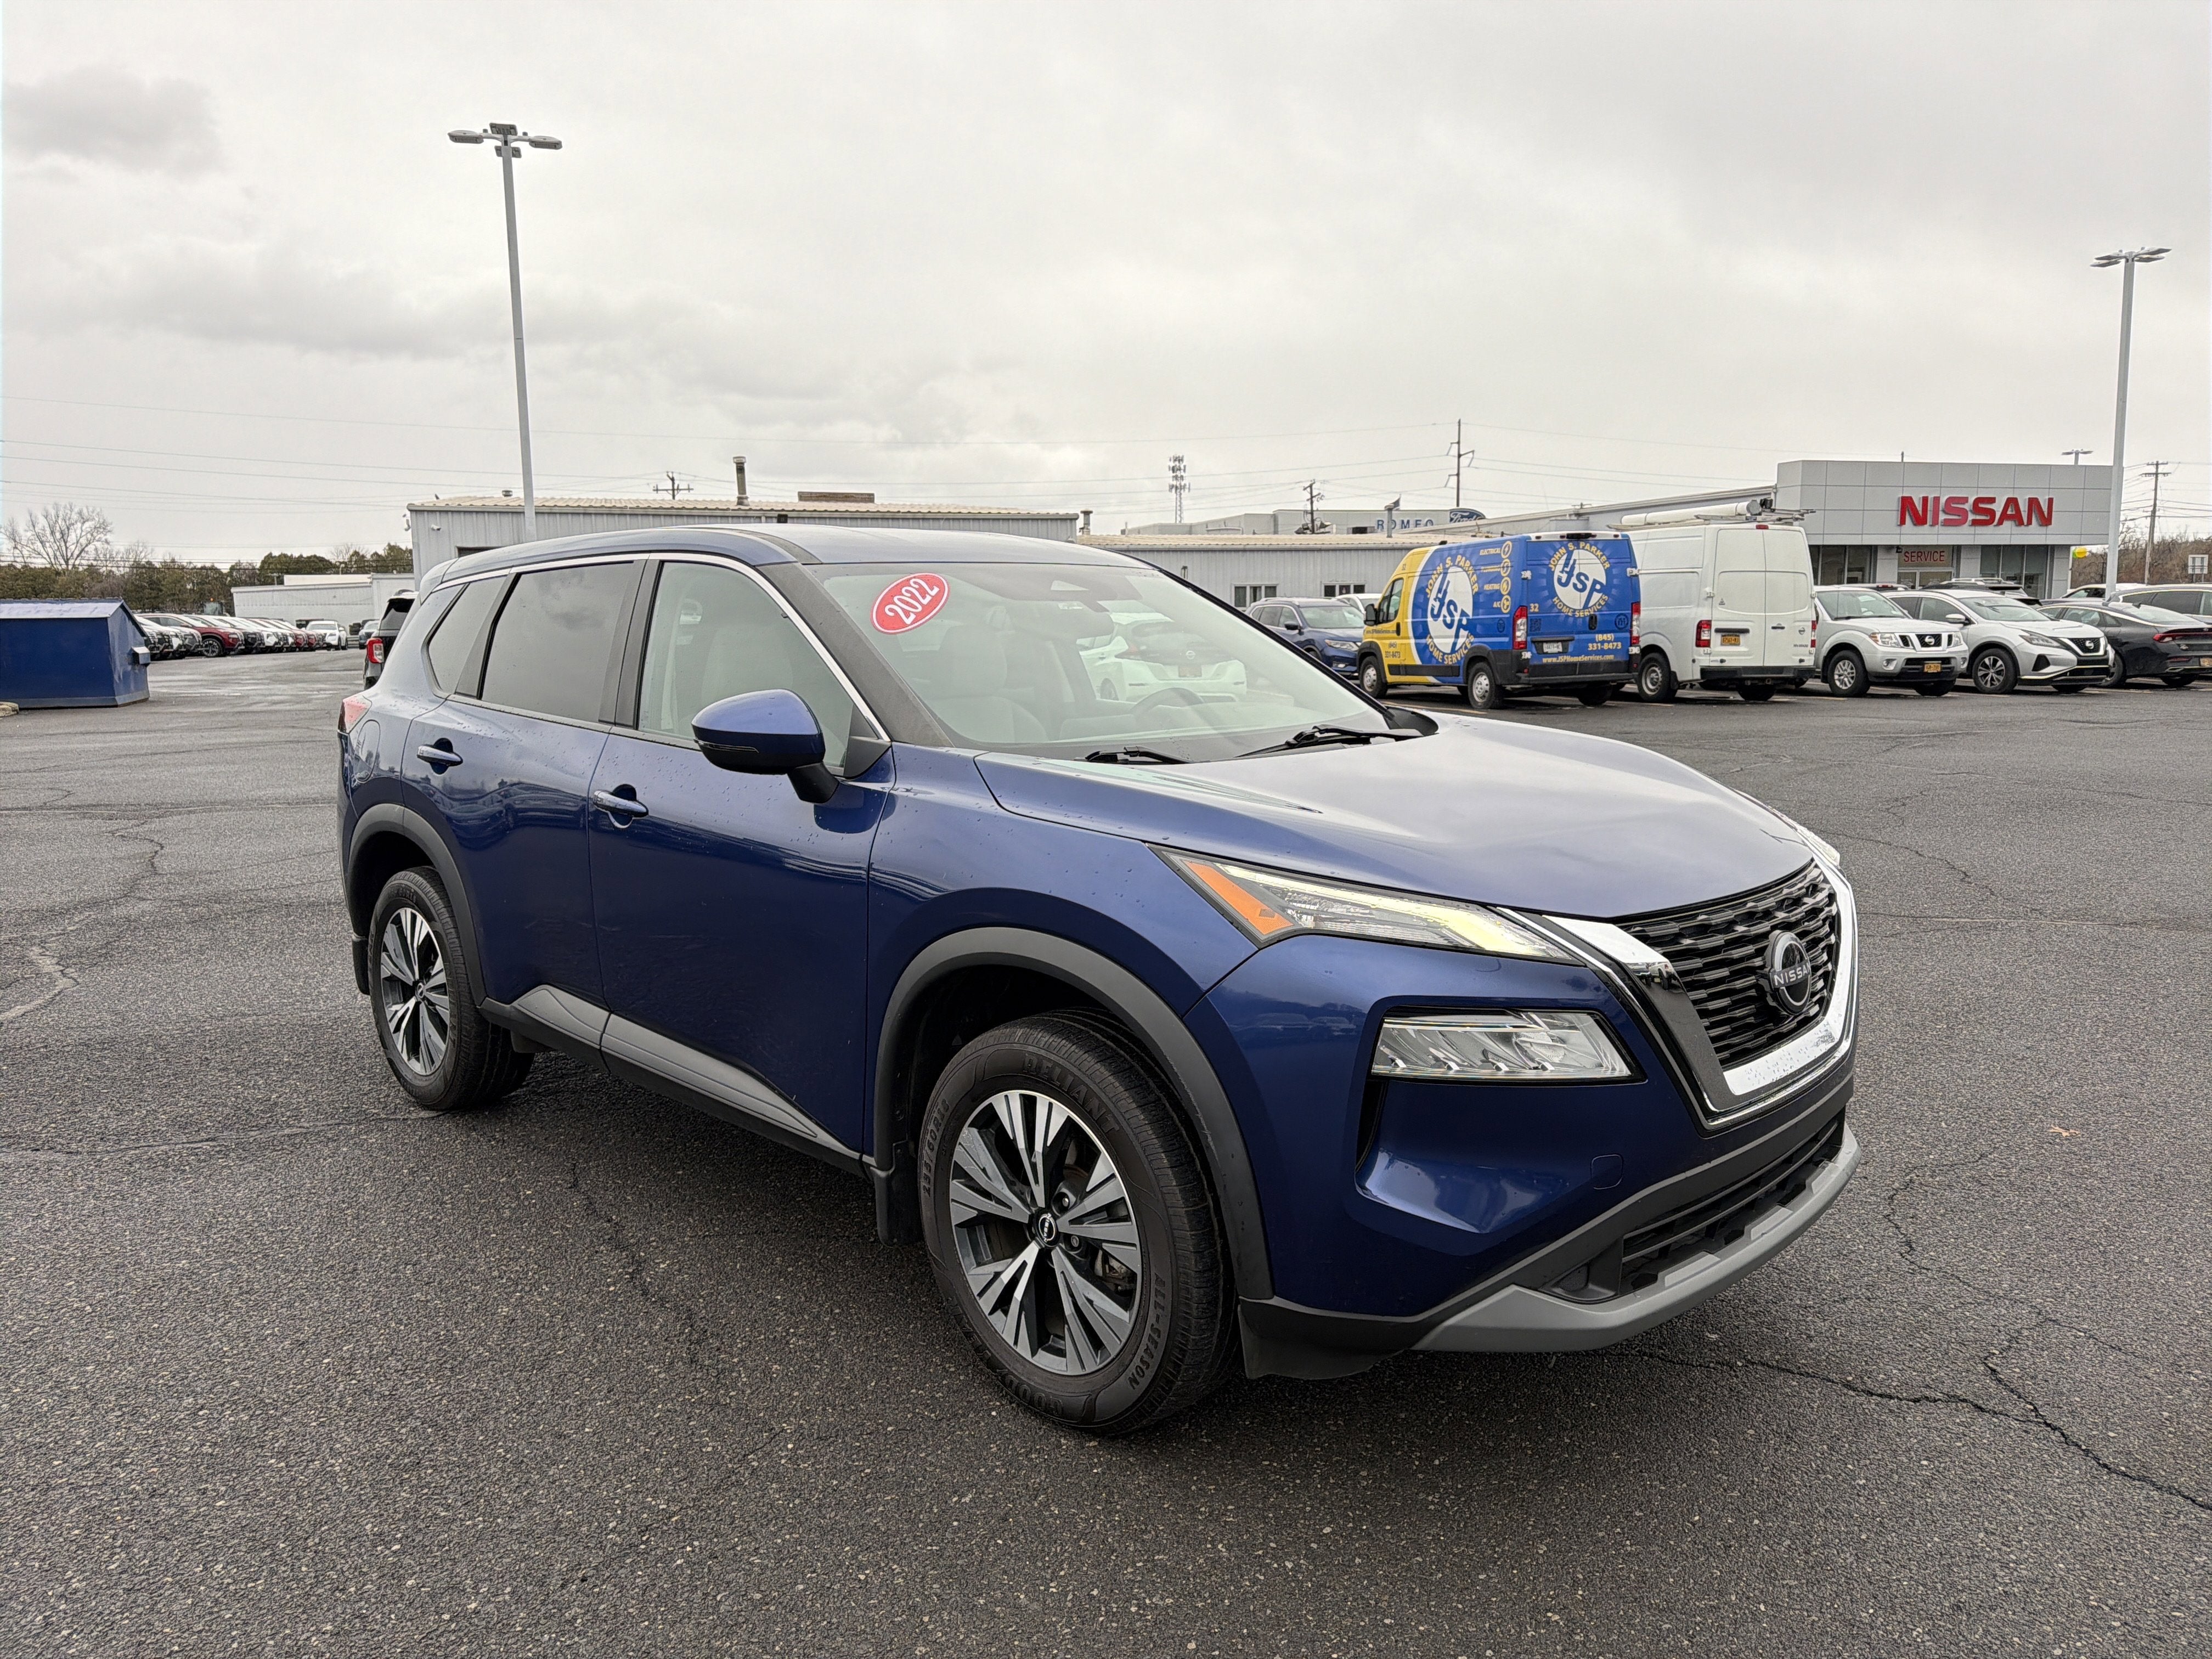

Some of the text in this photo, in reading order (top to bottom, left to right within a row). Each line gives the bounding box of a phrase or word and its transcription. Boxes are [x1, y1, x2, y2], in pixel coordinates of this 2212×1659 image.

[1451, 511, 1477, 523] Ford
[1899, 495, 2054, 526] NISSAN
[1549, 541, 1610, 572] JOHN S. PARKER
[1904, 550, 1945, 562] SERVICE
[1425, 563, 1443, 598] JOHN
[1455, 555, 1479, 595] PARKER
[884, 578, 940, 625] 2022
[1530, 603, 1539, 612] 32
[1553, 594, 1609, 617] HOME SERVICES
[1426, 633, 1475, 665] HOME SERVICES
[1588, 642, 1622, 651] 331-8473
[1595, 633, 1615, 642] (845)
[1774, 963, 1810, 985] NISSAN
[1023, 1052, 1120, 1134] RELIANT
[1127, 1272, 1166, 1390] ALL-SEASON
